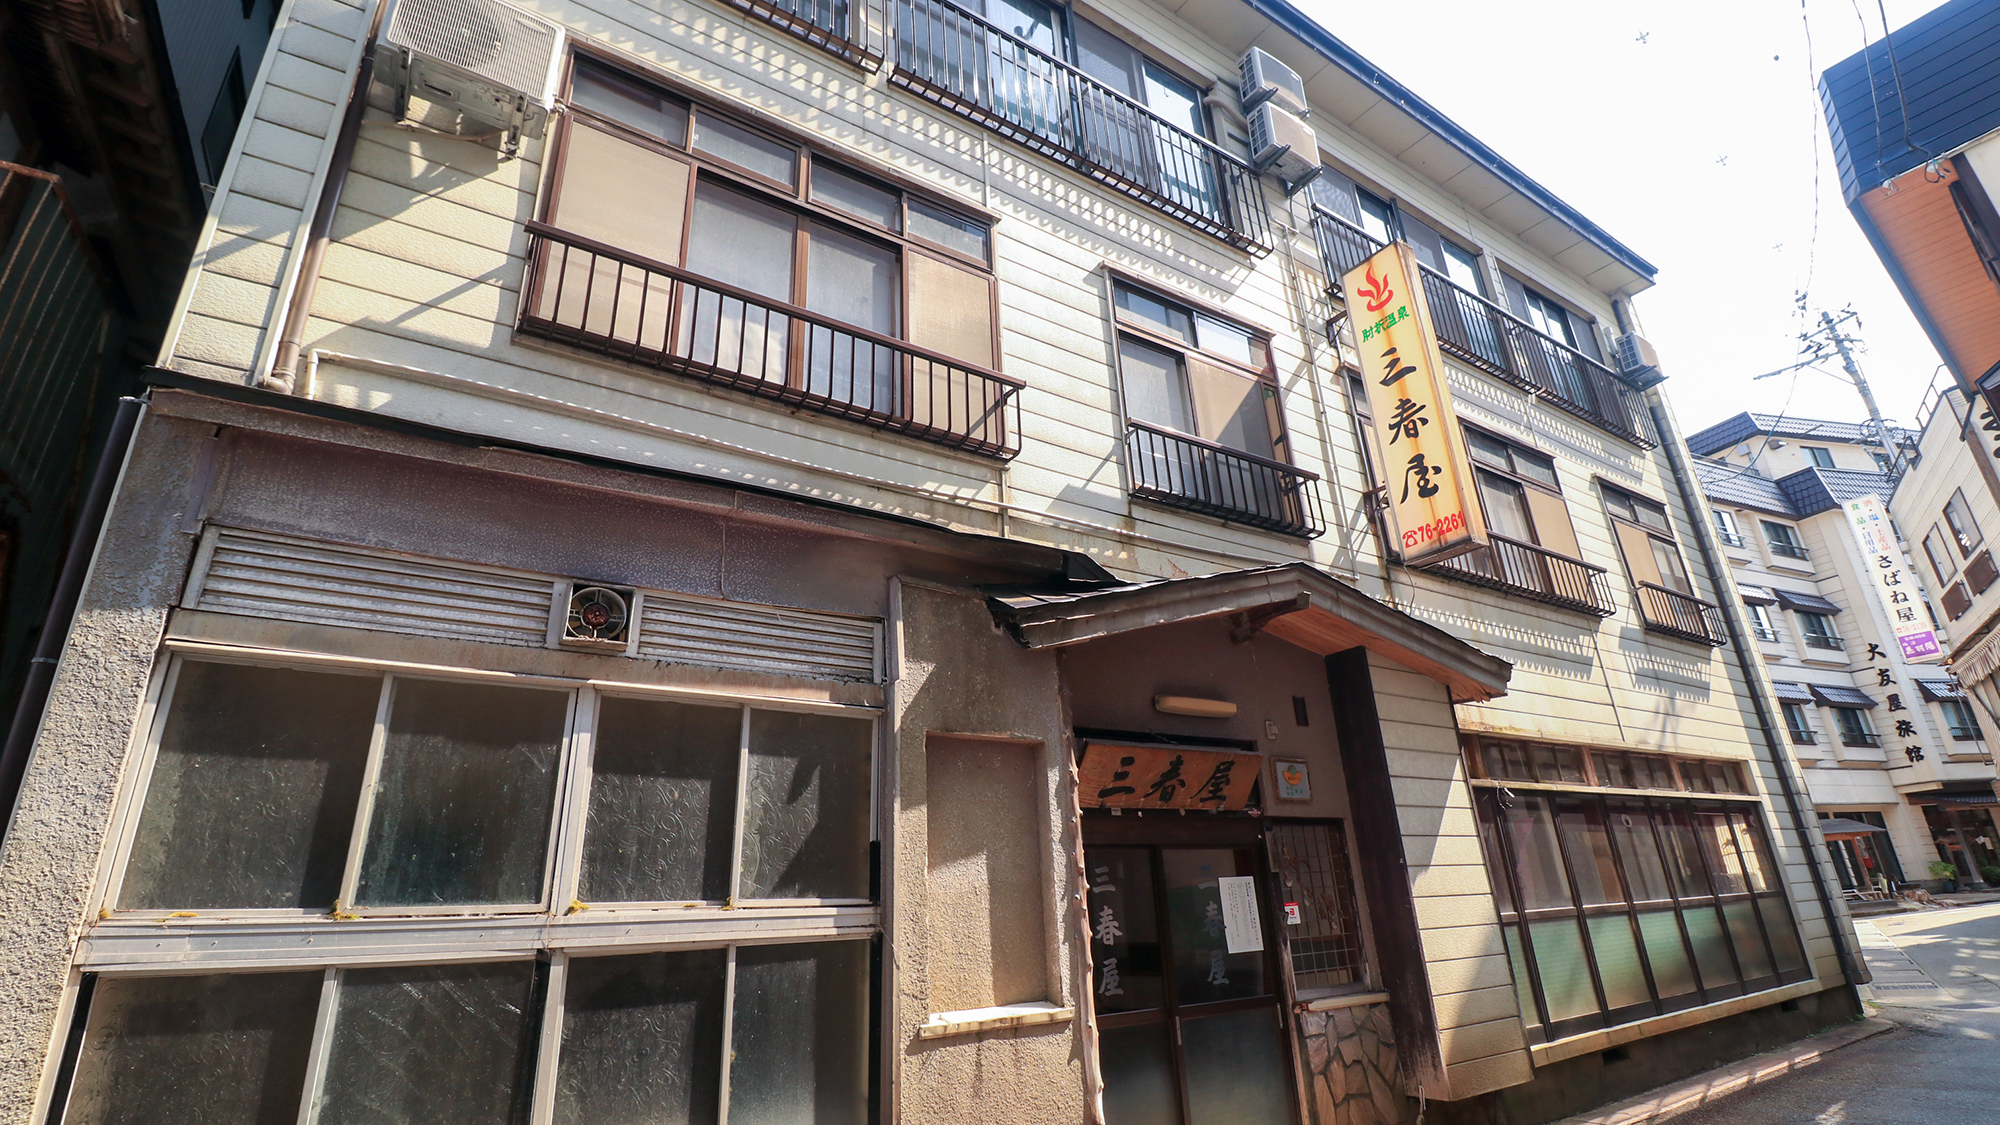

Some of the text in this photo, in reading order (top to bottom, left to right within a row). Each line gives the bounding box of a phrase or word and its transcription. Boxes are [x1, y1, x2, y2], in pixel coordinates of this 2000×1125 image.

[1361, 305, 1410, 343] 肘折温泉
[1379, 346, 1443, 505] 三春屋
[1417, 510, 1465, 543] 76-2261
[1877, 554, 1917, 623] さばね屋
[1867, 642, 1925, 763] 大友屋旅館
[1097, 754, 1236, 803] 三春屋
[1092, 865, 1125, 997] 三春屋
